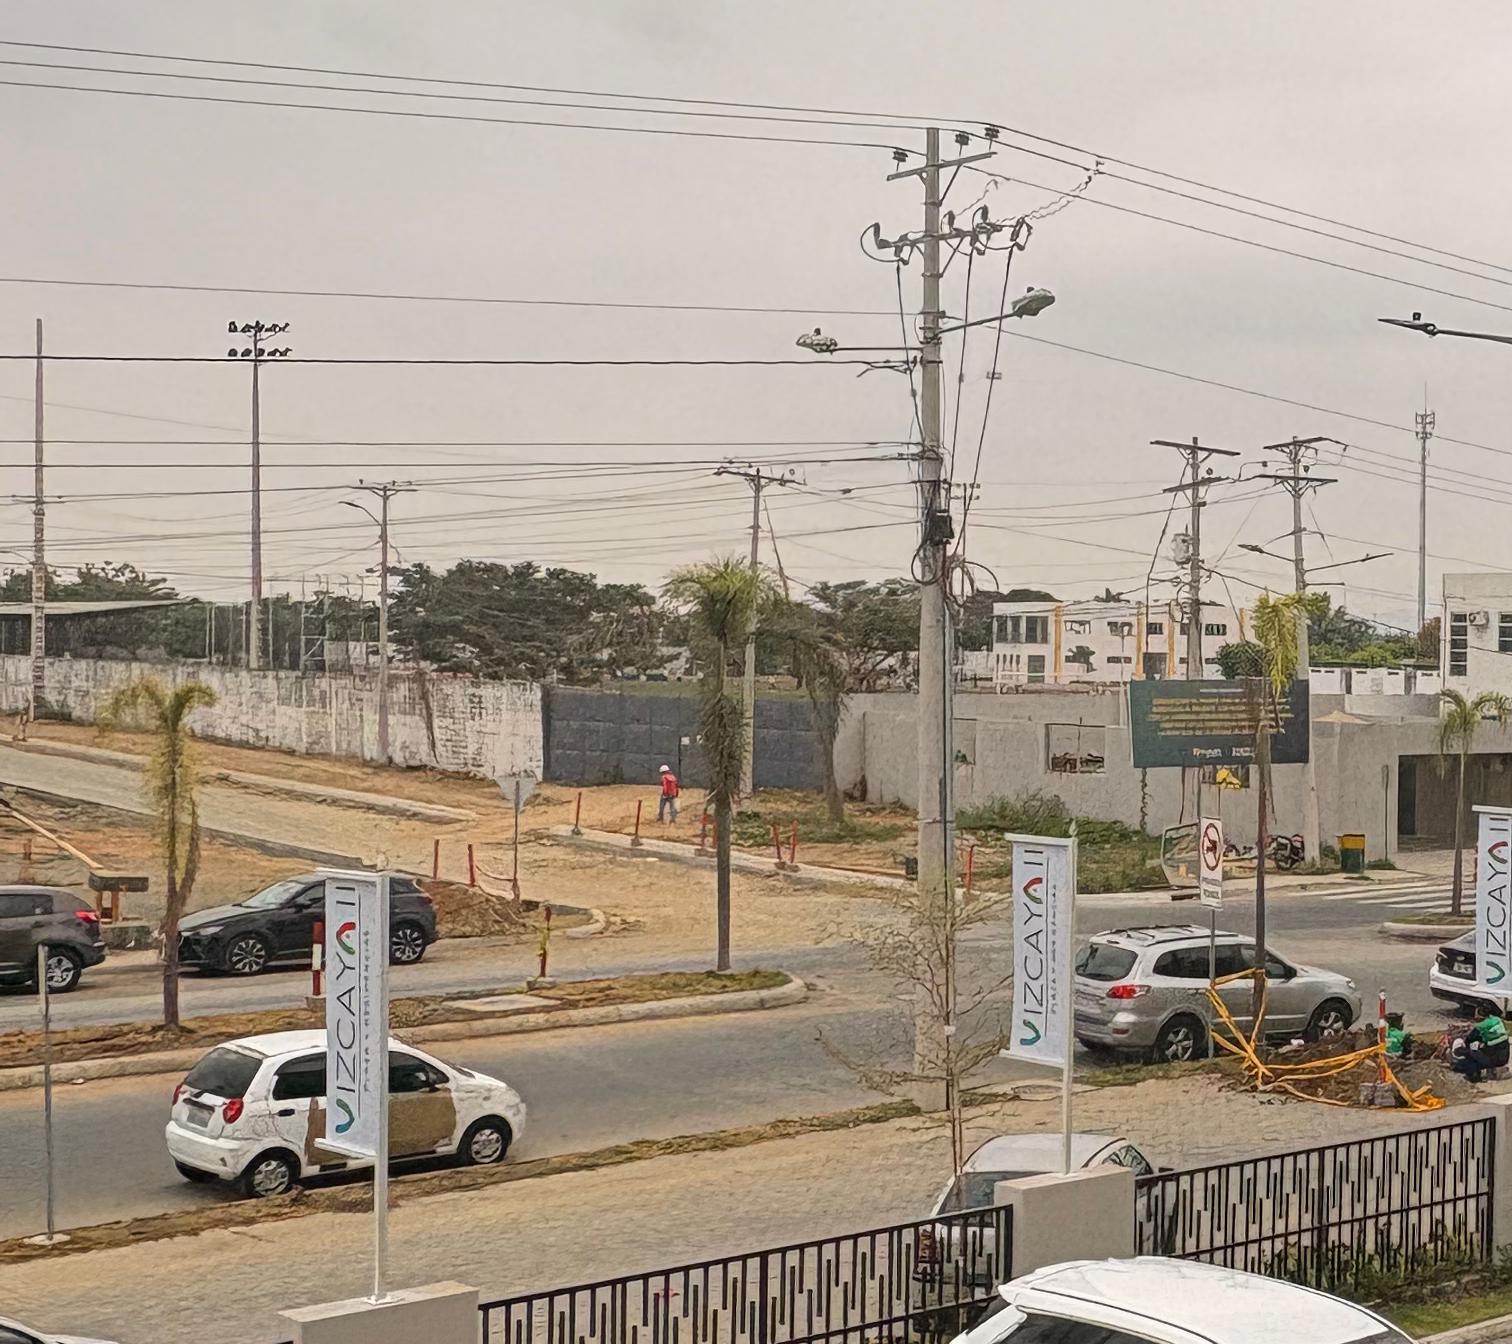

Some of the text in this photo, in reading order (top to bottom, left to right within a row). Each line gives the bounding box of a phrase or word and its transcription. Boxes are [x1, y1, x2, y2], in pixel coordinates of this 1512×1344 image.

[335, 885, 357, 1134] VIZCAYA II
[1019, 849, 1044, 1046] VIZCAYA II
[1485, 840, 1509, 985] VIZCAYA
